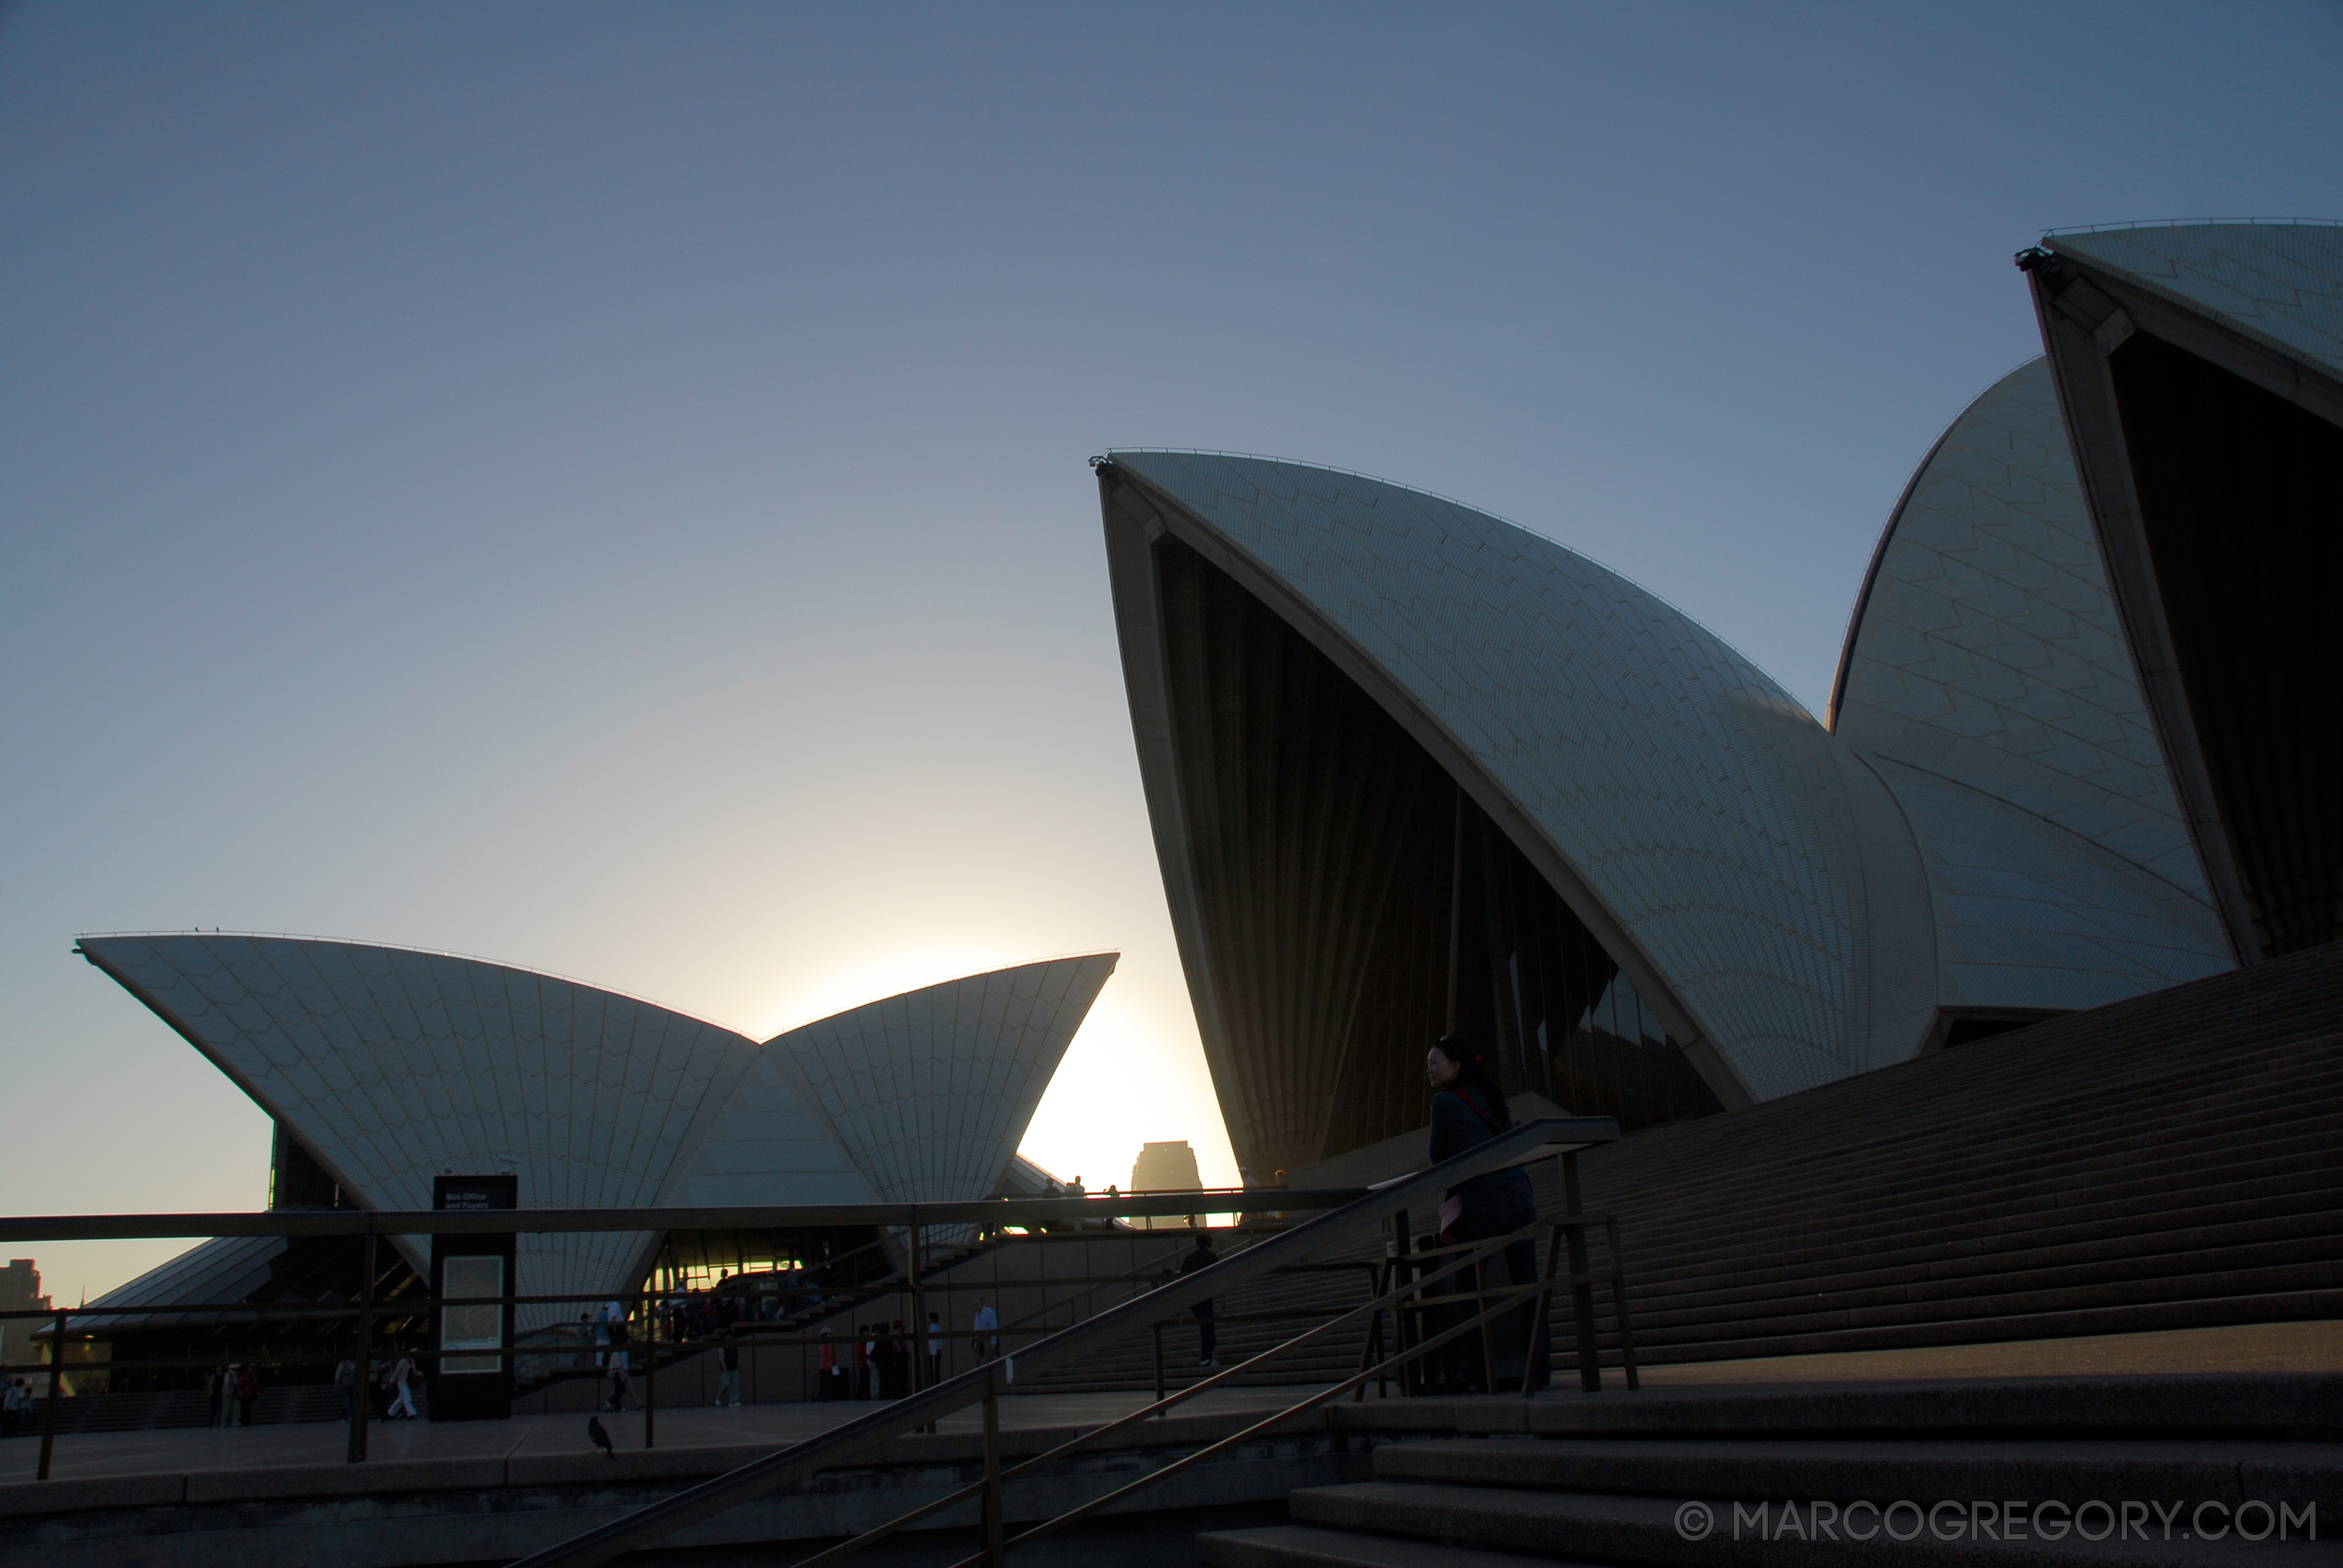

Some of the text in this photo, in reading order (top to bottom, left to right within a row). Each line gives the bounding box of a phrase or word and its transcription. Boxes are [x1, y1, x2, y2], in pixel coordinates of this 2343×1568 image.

[445, 1192, 487, 1201] Box Office
[462, 1201, 488, 1210] Foyers
